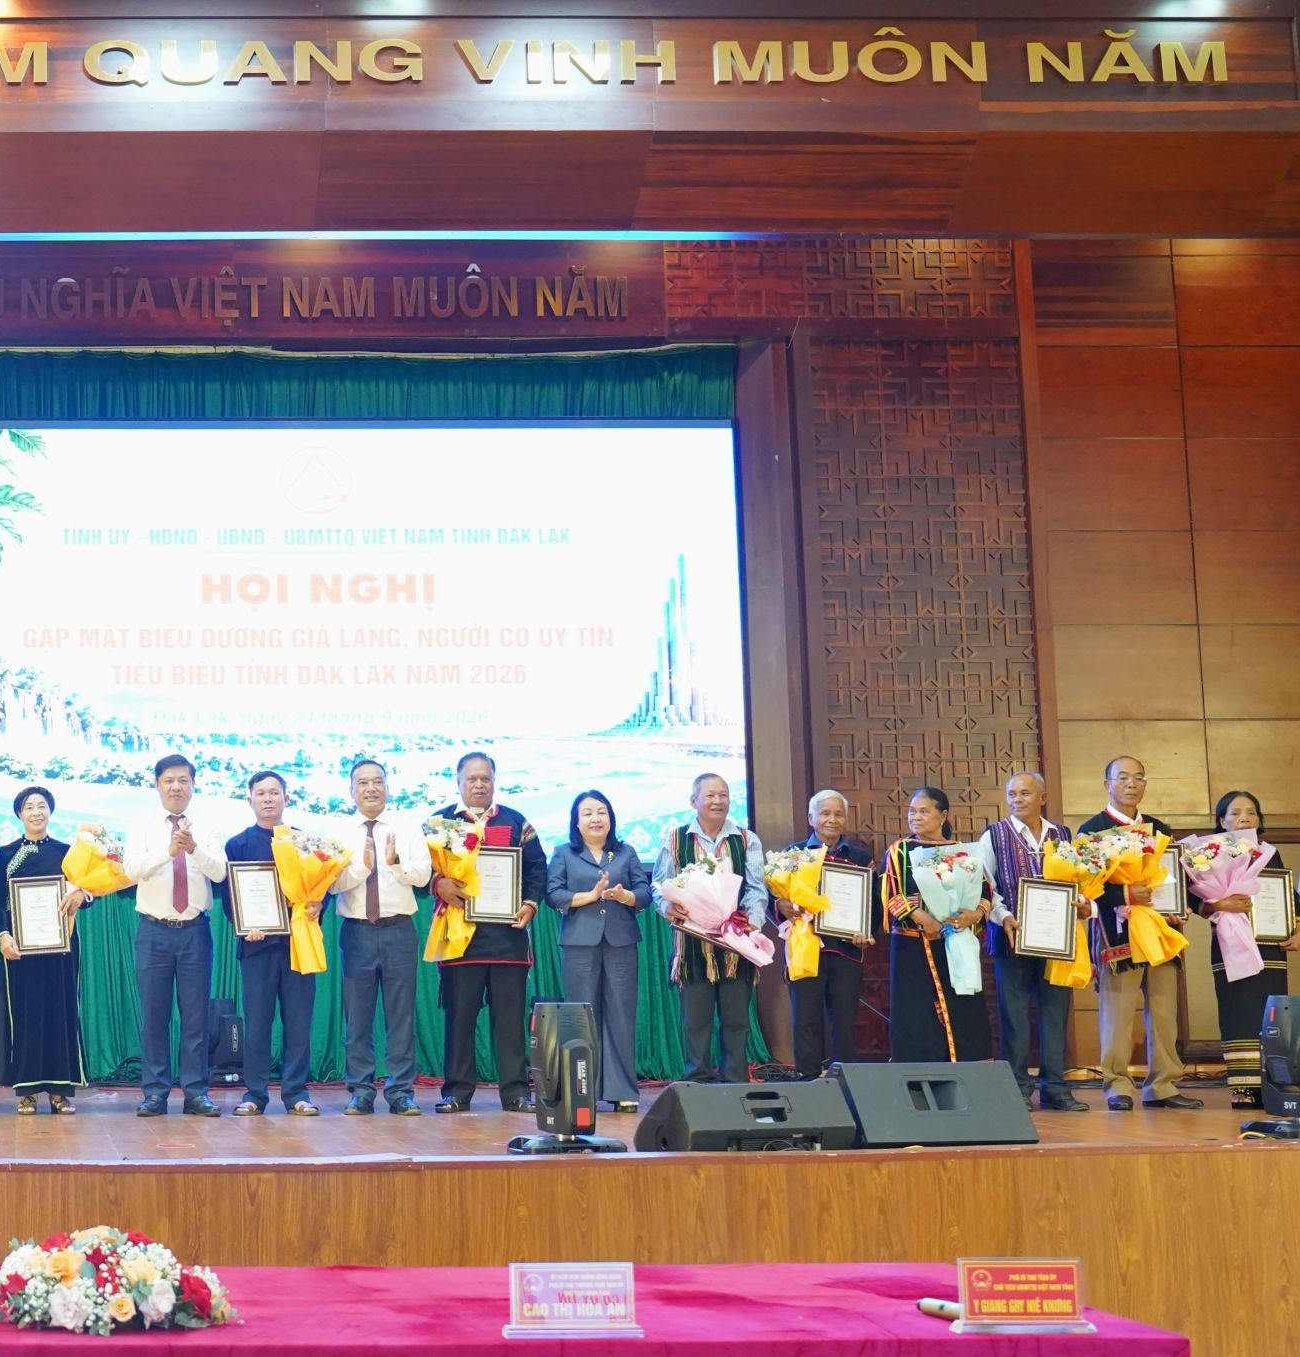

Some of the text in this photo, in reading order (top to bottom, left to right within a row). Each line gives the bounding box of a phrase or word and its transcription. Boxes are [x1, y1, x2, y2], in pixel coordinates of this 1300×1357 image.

[83, 39, 424, 87] QUANG
[456, 39, 677, 84] VINH
[714, 27, 988, 85] MUÔN
[1027, 28, 1229, 84] NĂM
[20, 266, 159, 319] NGHĨA
[171, 265, 268, 326] VIỆT
[281, 275, 376, 319] NAM
[392, 263, 519, 318] MUÔN
[534, 264, 629, 319] NĂM
[403, 528, 445, 545] NAM
[201, 566, 435, 613] HỘI NGHỊ
[469, 665, 527, 685] 2026
[1283, 1101, 1298, 1110] SVT
[523, 1302, 549, 1317] CAO
